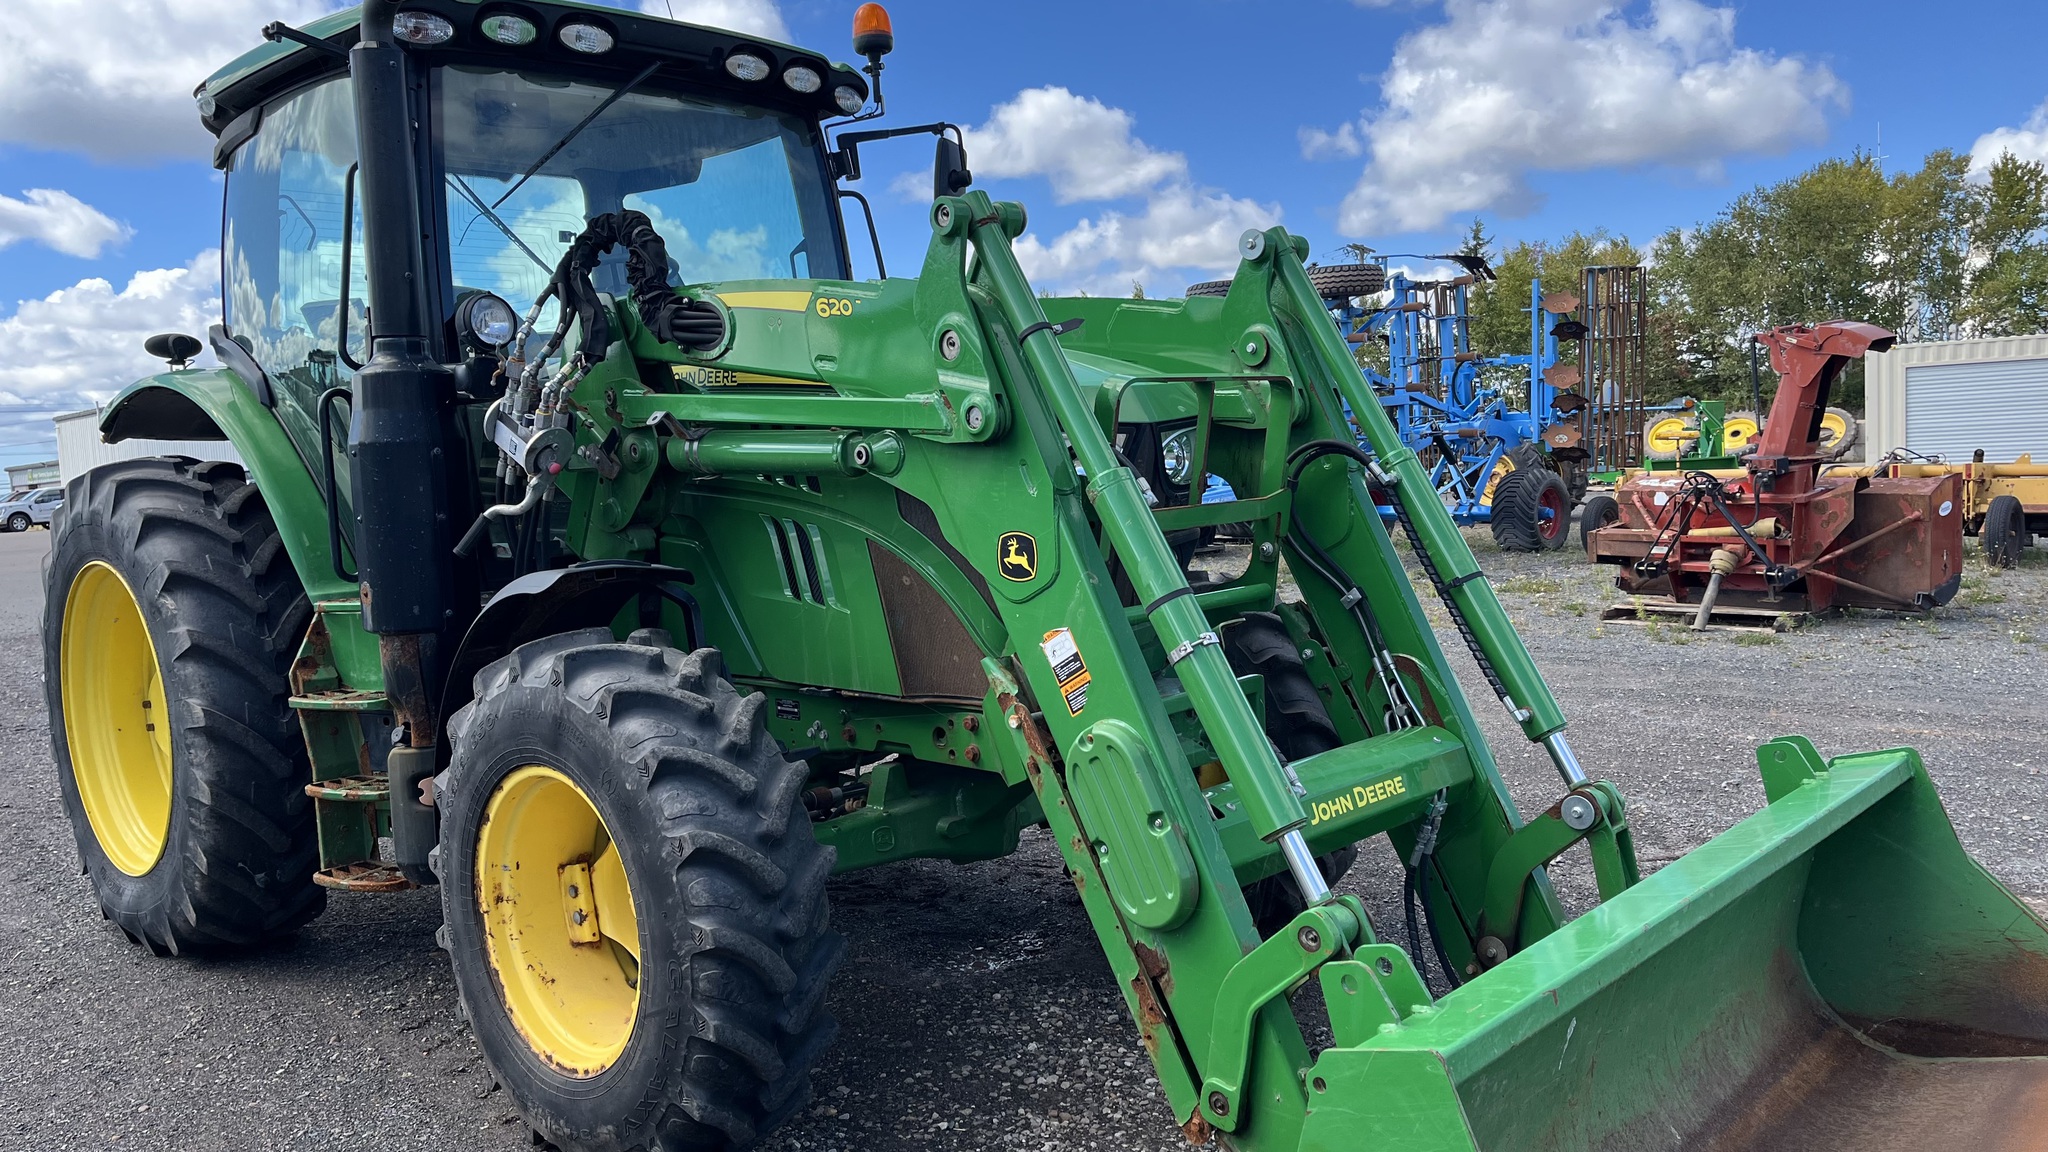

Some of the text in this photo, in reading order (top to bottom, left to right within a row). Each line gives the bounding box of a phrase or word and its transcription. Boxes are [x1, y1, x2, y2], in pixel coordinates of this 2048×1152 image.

[815, 297, 853, 318] 620
[697, 368, 738, 385] DEERE
[1310, 775, 1406, 826] JOHN DEERE
